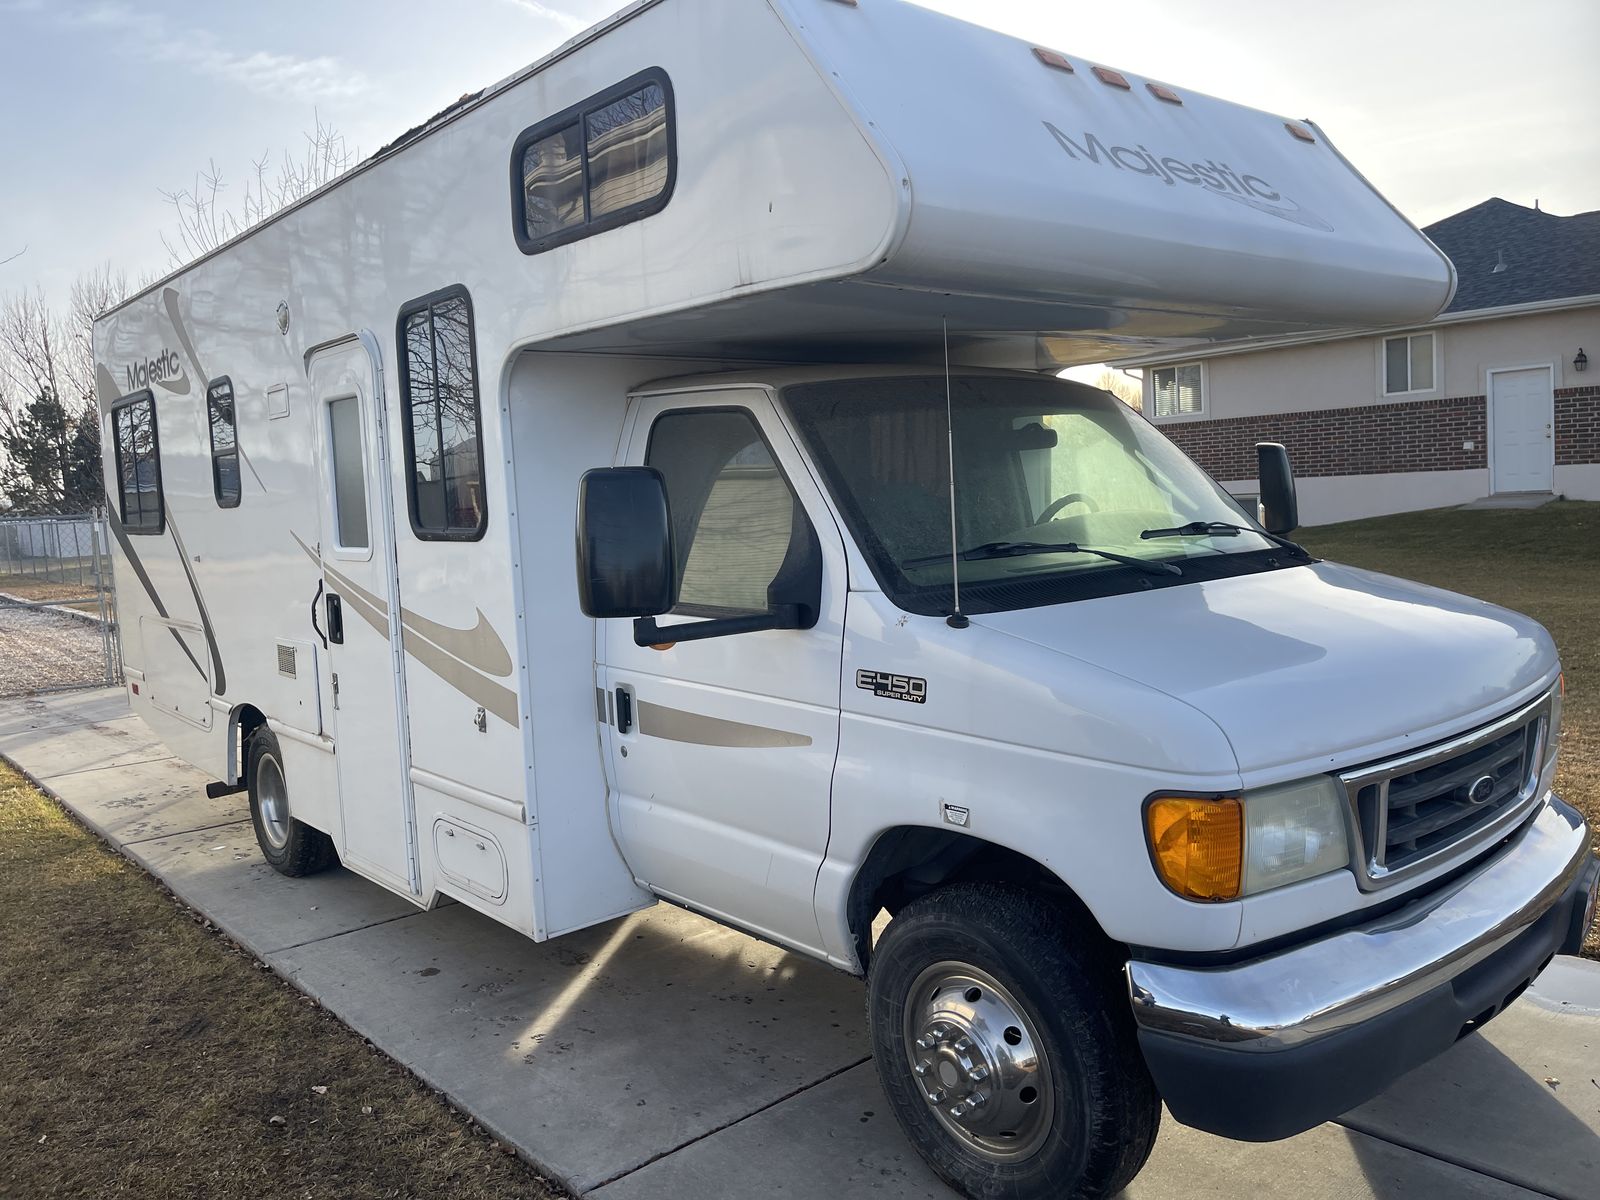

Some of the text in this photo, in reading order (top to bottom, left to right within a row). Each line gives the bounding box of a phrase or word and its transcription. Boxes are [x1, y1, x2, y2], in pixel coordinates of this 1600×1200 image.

[1041, 120, 1281, 202] Majestic
[126, 348, 180, 391] Majestic
[857, 670, 926, 696] E-450
[876, 690, 923, 702] SUPER DUTY
